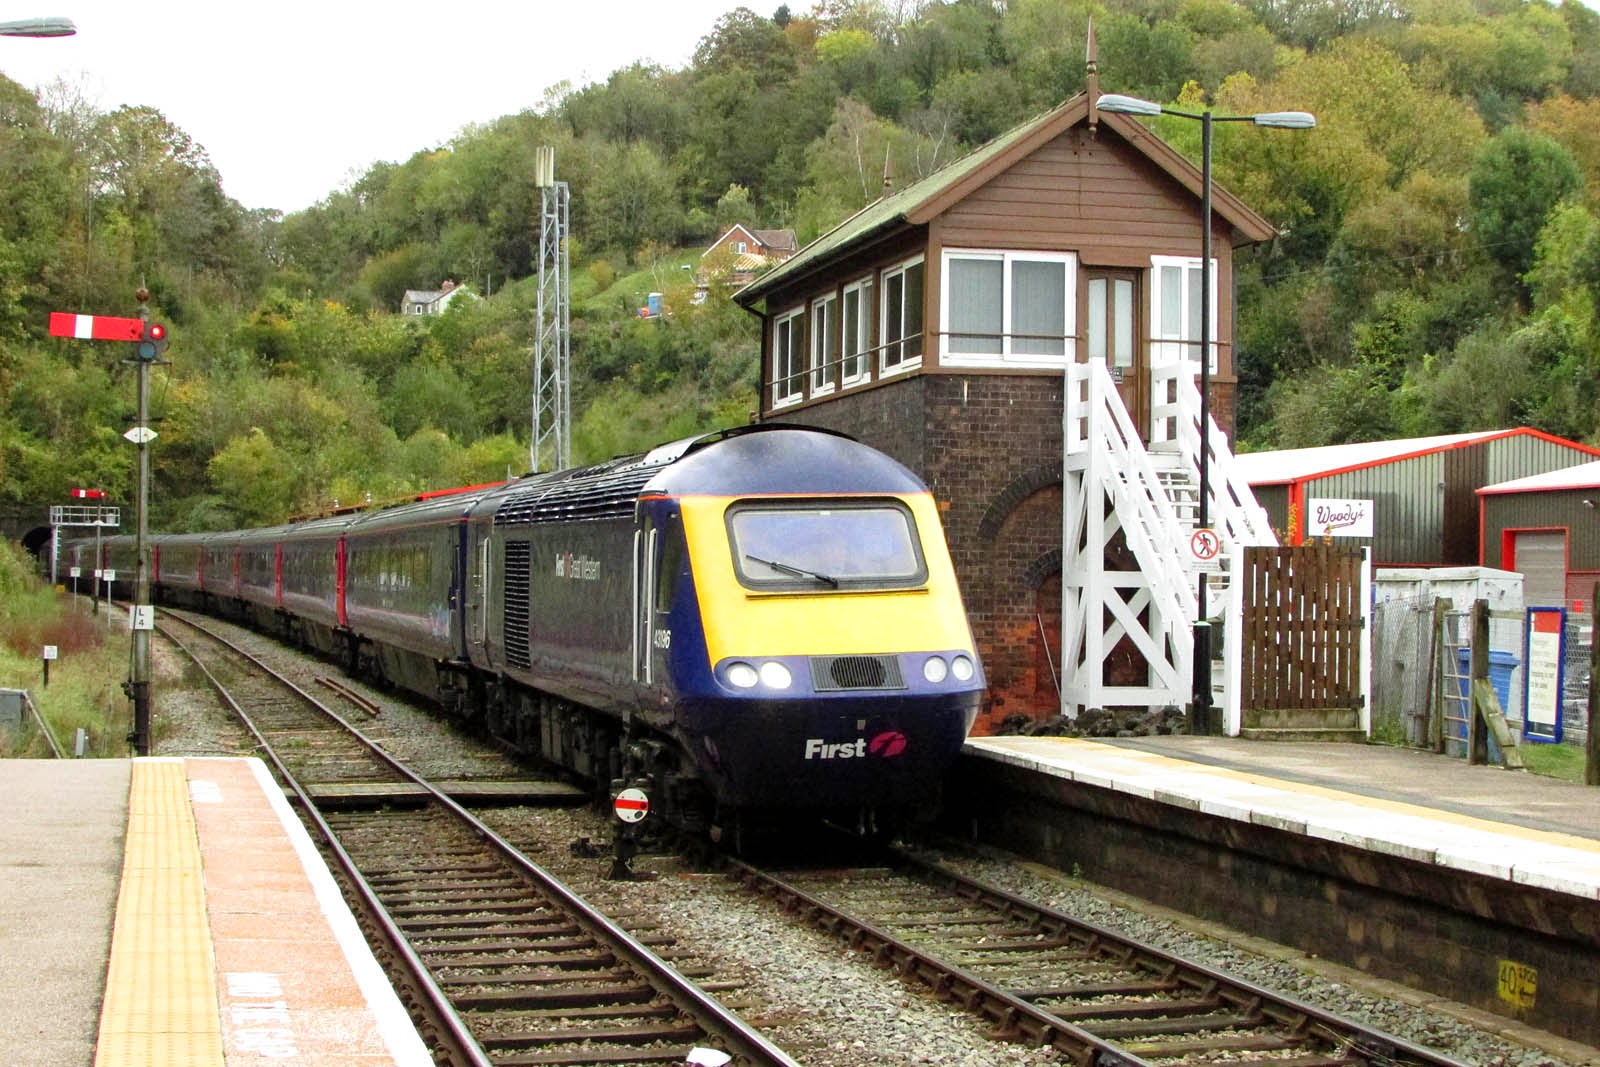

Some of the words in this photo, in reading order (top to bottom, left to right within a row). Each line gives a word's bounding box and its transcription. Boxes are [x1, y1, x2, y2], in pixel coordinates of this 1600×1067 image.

[138, 608, 145, 617] L
[138, 619, 145, 627] 4
[804, 738, 867, 760] First
